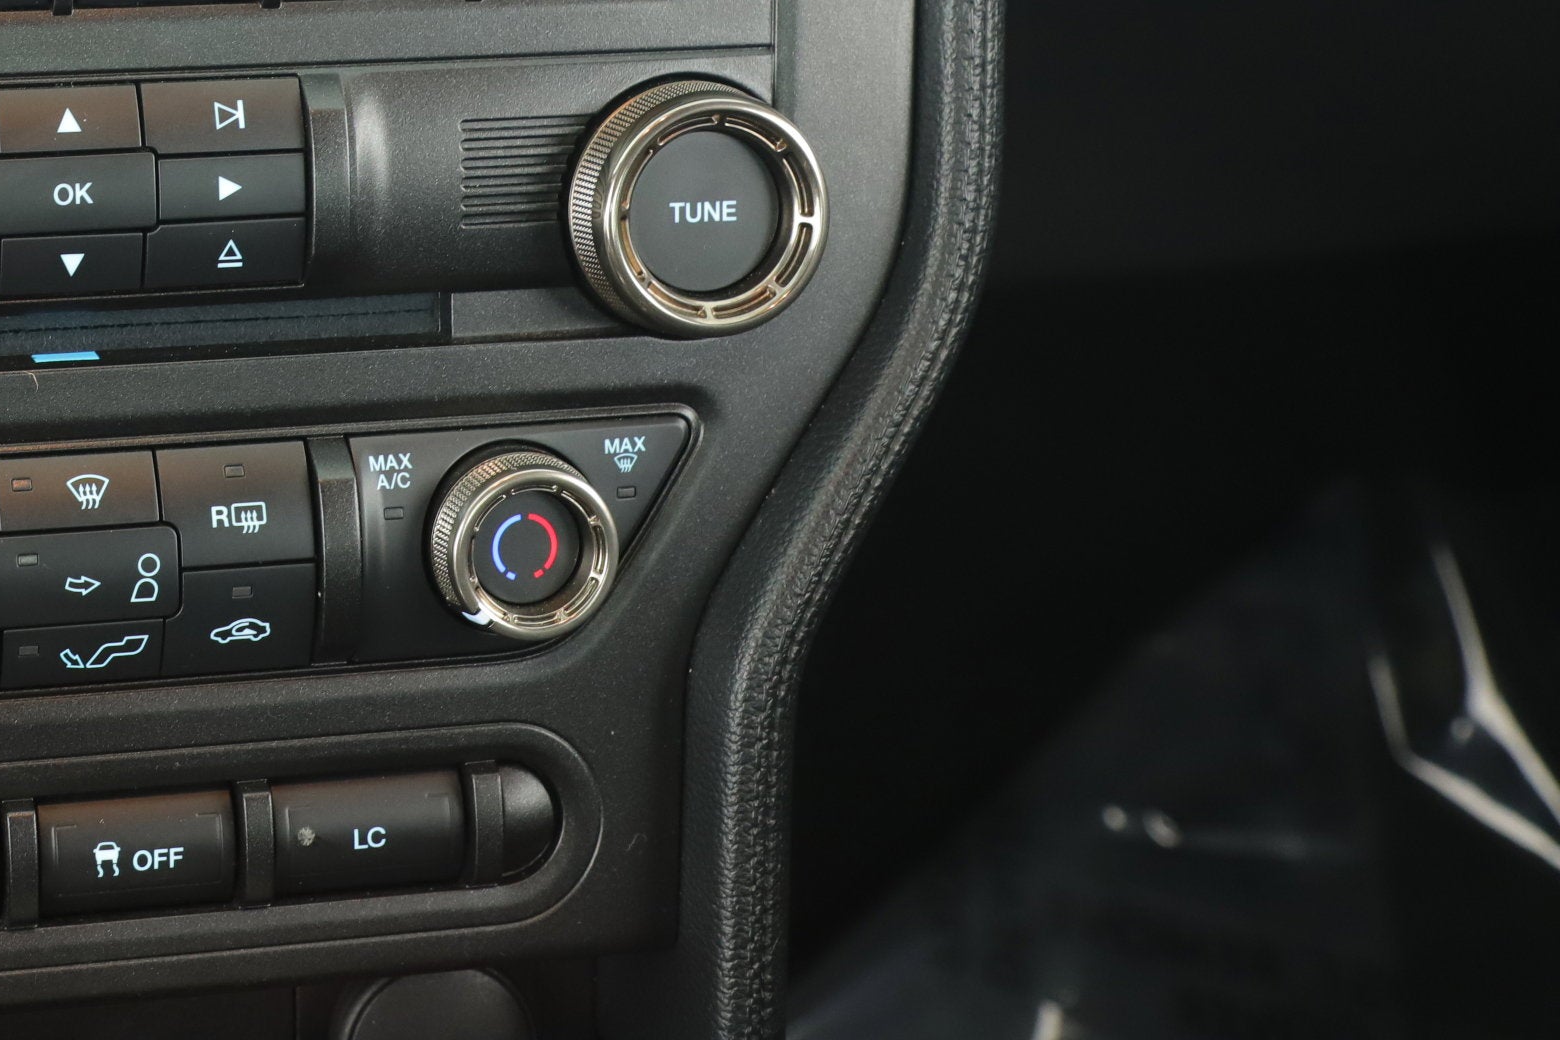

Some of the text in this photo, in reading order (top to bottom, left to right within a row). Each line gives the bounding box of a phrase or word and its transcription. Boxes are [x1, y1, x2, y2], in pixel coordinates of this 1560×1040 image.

[52, 181, 95, 207] OK
[668, 199, 738, 224] TUNE
[604, 435, 646, 454] MAX
[368, 452, 413, 471] MAX
[376, 471, 411, 490] A/C
[210, 504, 230, 529] R
[352, 825, 387, 851] LC
[131, 845, 185, 872] OFF
